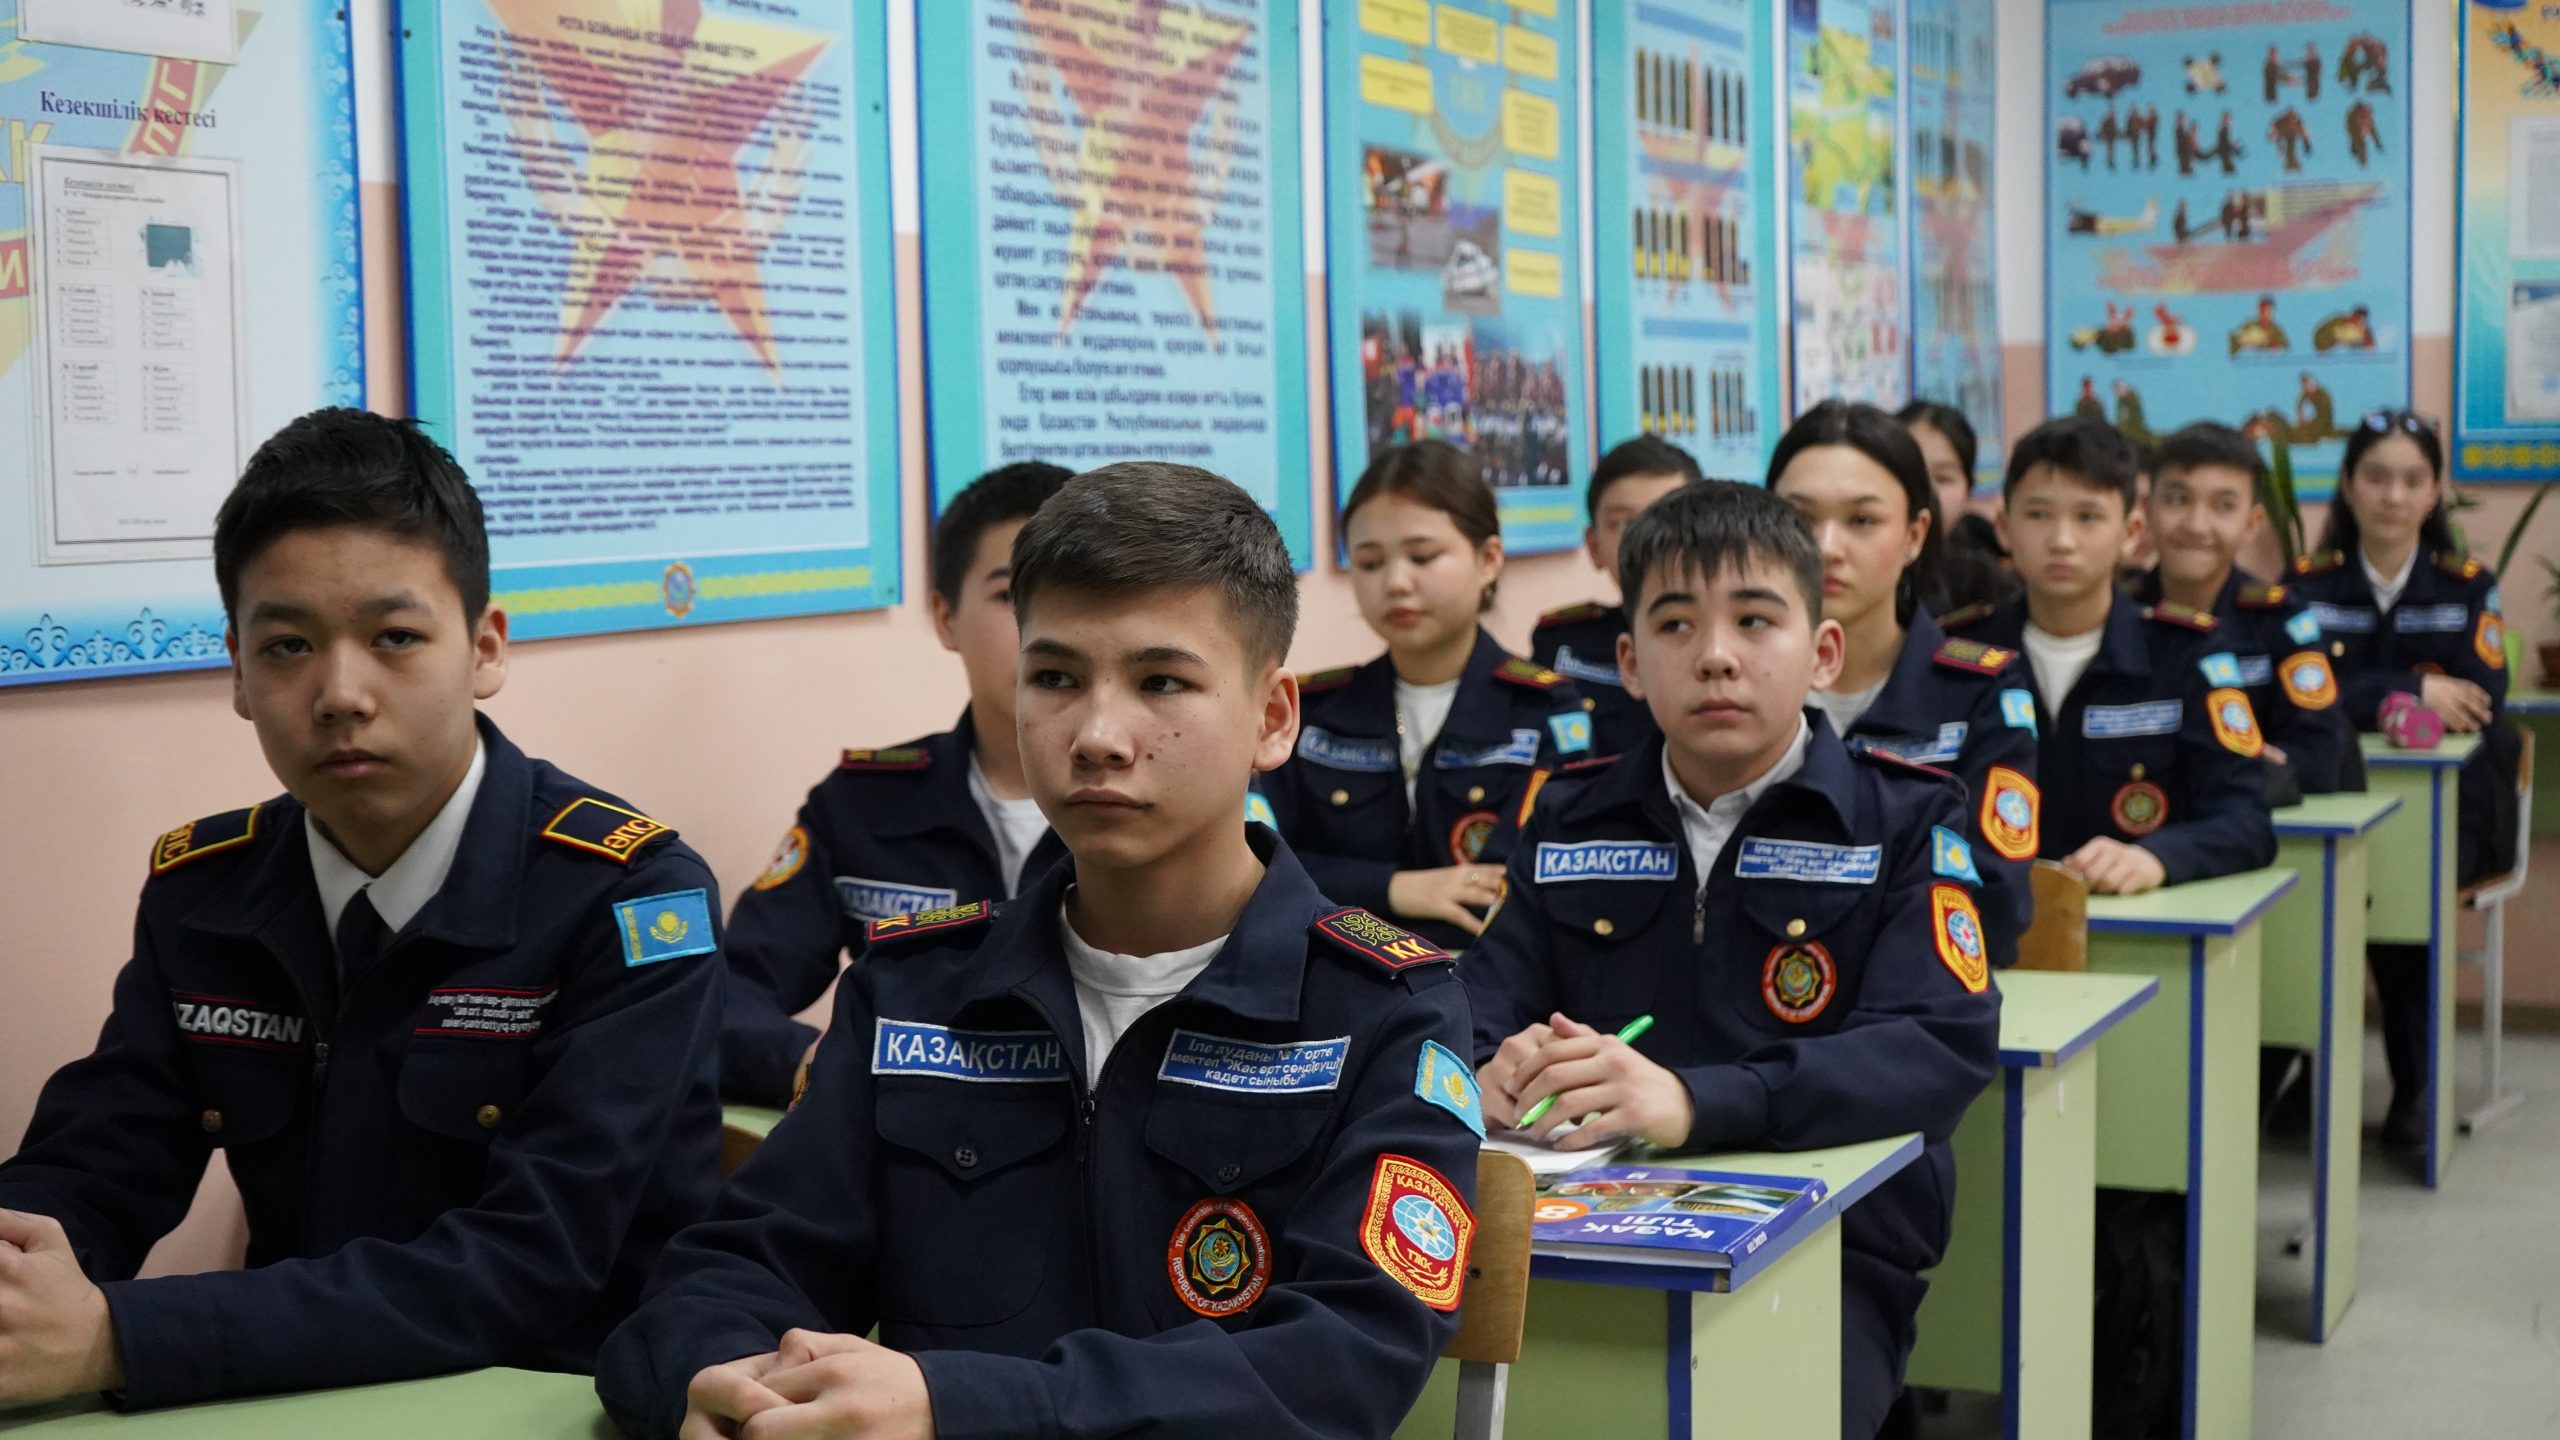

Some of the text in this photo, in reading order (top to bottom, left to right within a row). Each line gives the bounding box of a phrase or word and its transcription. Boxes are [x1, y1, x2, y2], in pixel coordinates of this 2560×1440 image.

[40, 89, 217, 129] Кезекшілік кестесі
[173, 1001, 304, 1043] ZAQSTAN
[887, 1033, 1061, 1074] ҚАЗАҚСТАН
[1215, 1043, 1275, 1062] ауданы
[1205, 1069, 1245, 1086] кадет
[1534, 1204, 1579, 1219] 8
[1210, 1274, 1264, 1312] KAZAKHSTAN
